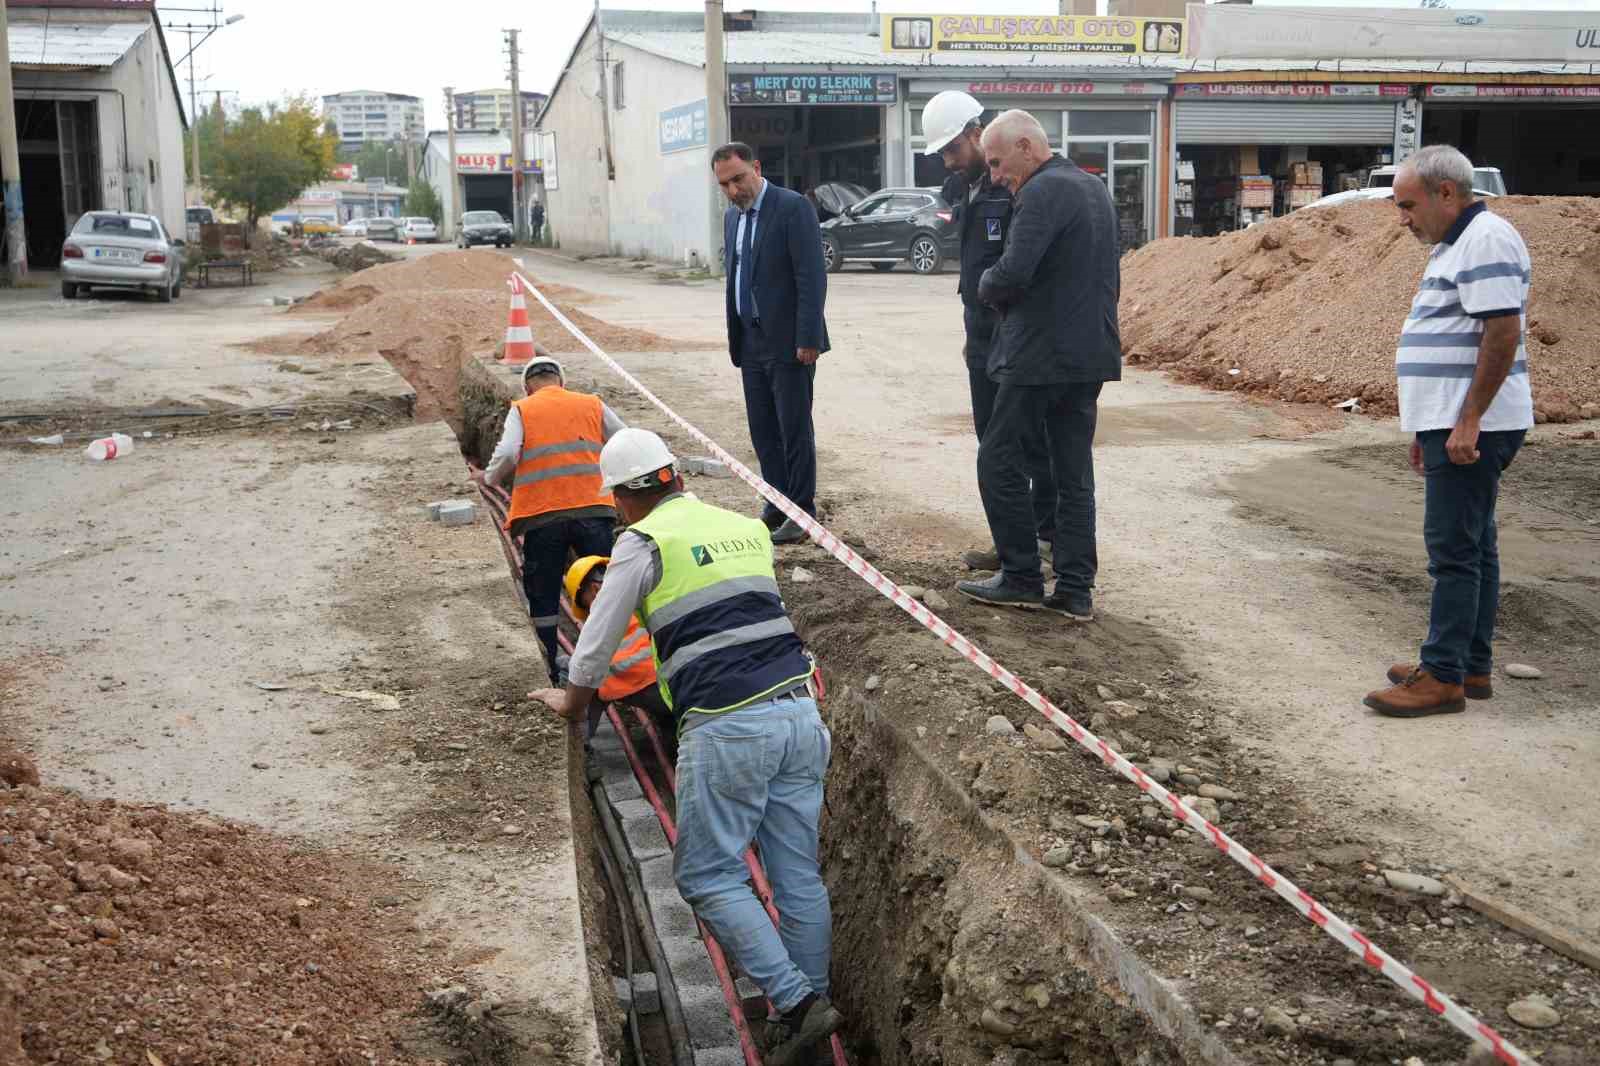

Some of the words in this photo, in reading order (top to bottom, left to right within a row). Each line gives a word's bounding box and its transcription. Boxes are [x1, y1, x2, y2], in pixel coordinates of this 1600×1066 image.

[940, 15, 1074, 38] ÇALIŞKAN
[1083, 18, 1136, 37] OTO
[950, 43, 973, 51] HER
[754, 77, 788, 89] MERT
[791, 77, 816, 89] OTO
[820, 75, 872, 89] ELEKRİK
[1061, 82, 1095, 94] OTO
[1297, 85, 1325, 95] OTO
